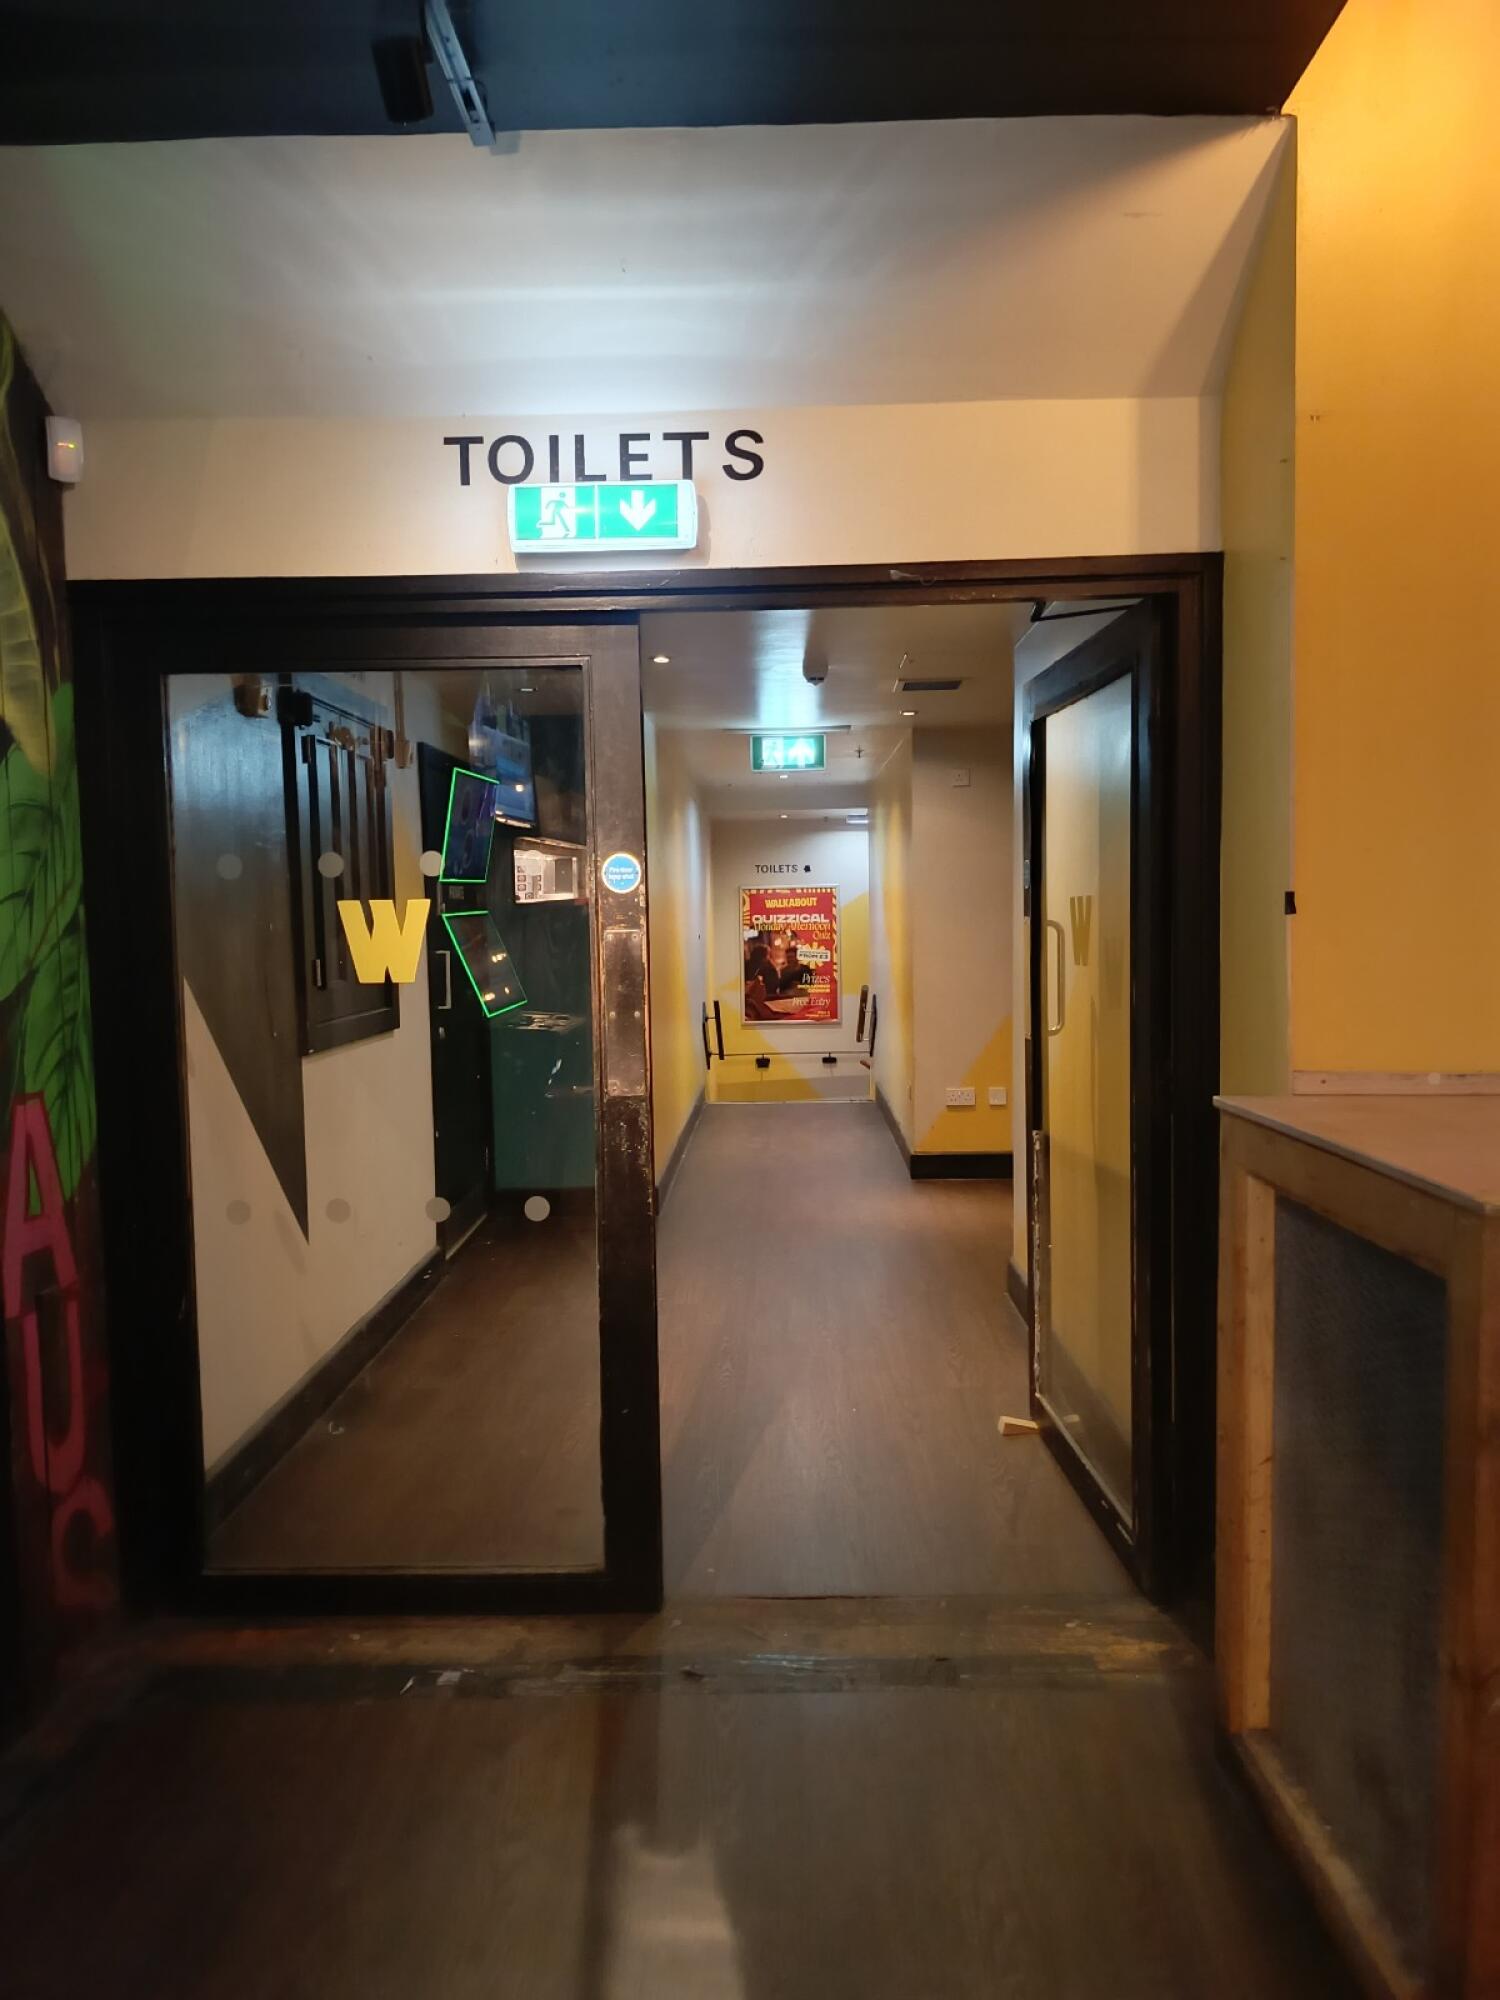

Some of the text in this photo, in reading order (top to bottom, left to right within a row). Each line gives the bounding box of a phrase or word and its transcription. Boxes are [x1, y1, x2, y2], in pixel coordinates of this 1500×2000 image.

[444, 429, 765, 486] TOILETS
[754, 864, 799, 874] TOILETS
[765, 897, 818, 909] WALKABOUT
[752, 913, 830, 923] QUIZZICAL
[1069, 895, 1092, 967] W
[337, 898, 431, 984] W
[801, 971, 831, 985] Prizes
